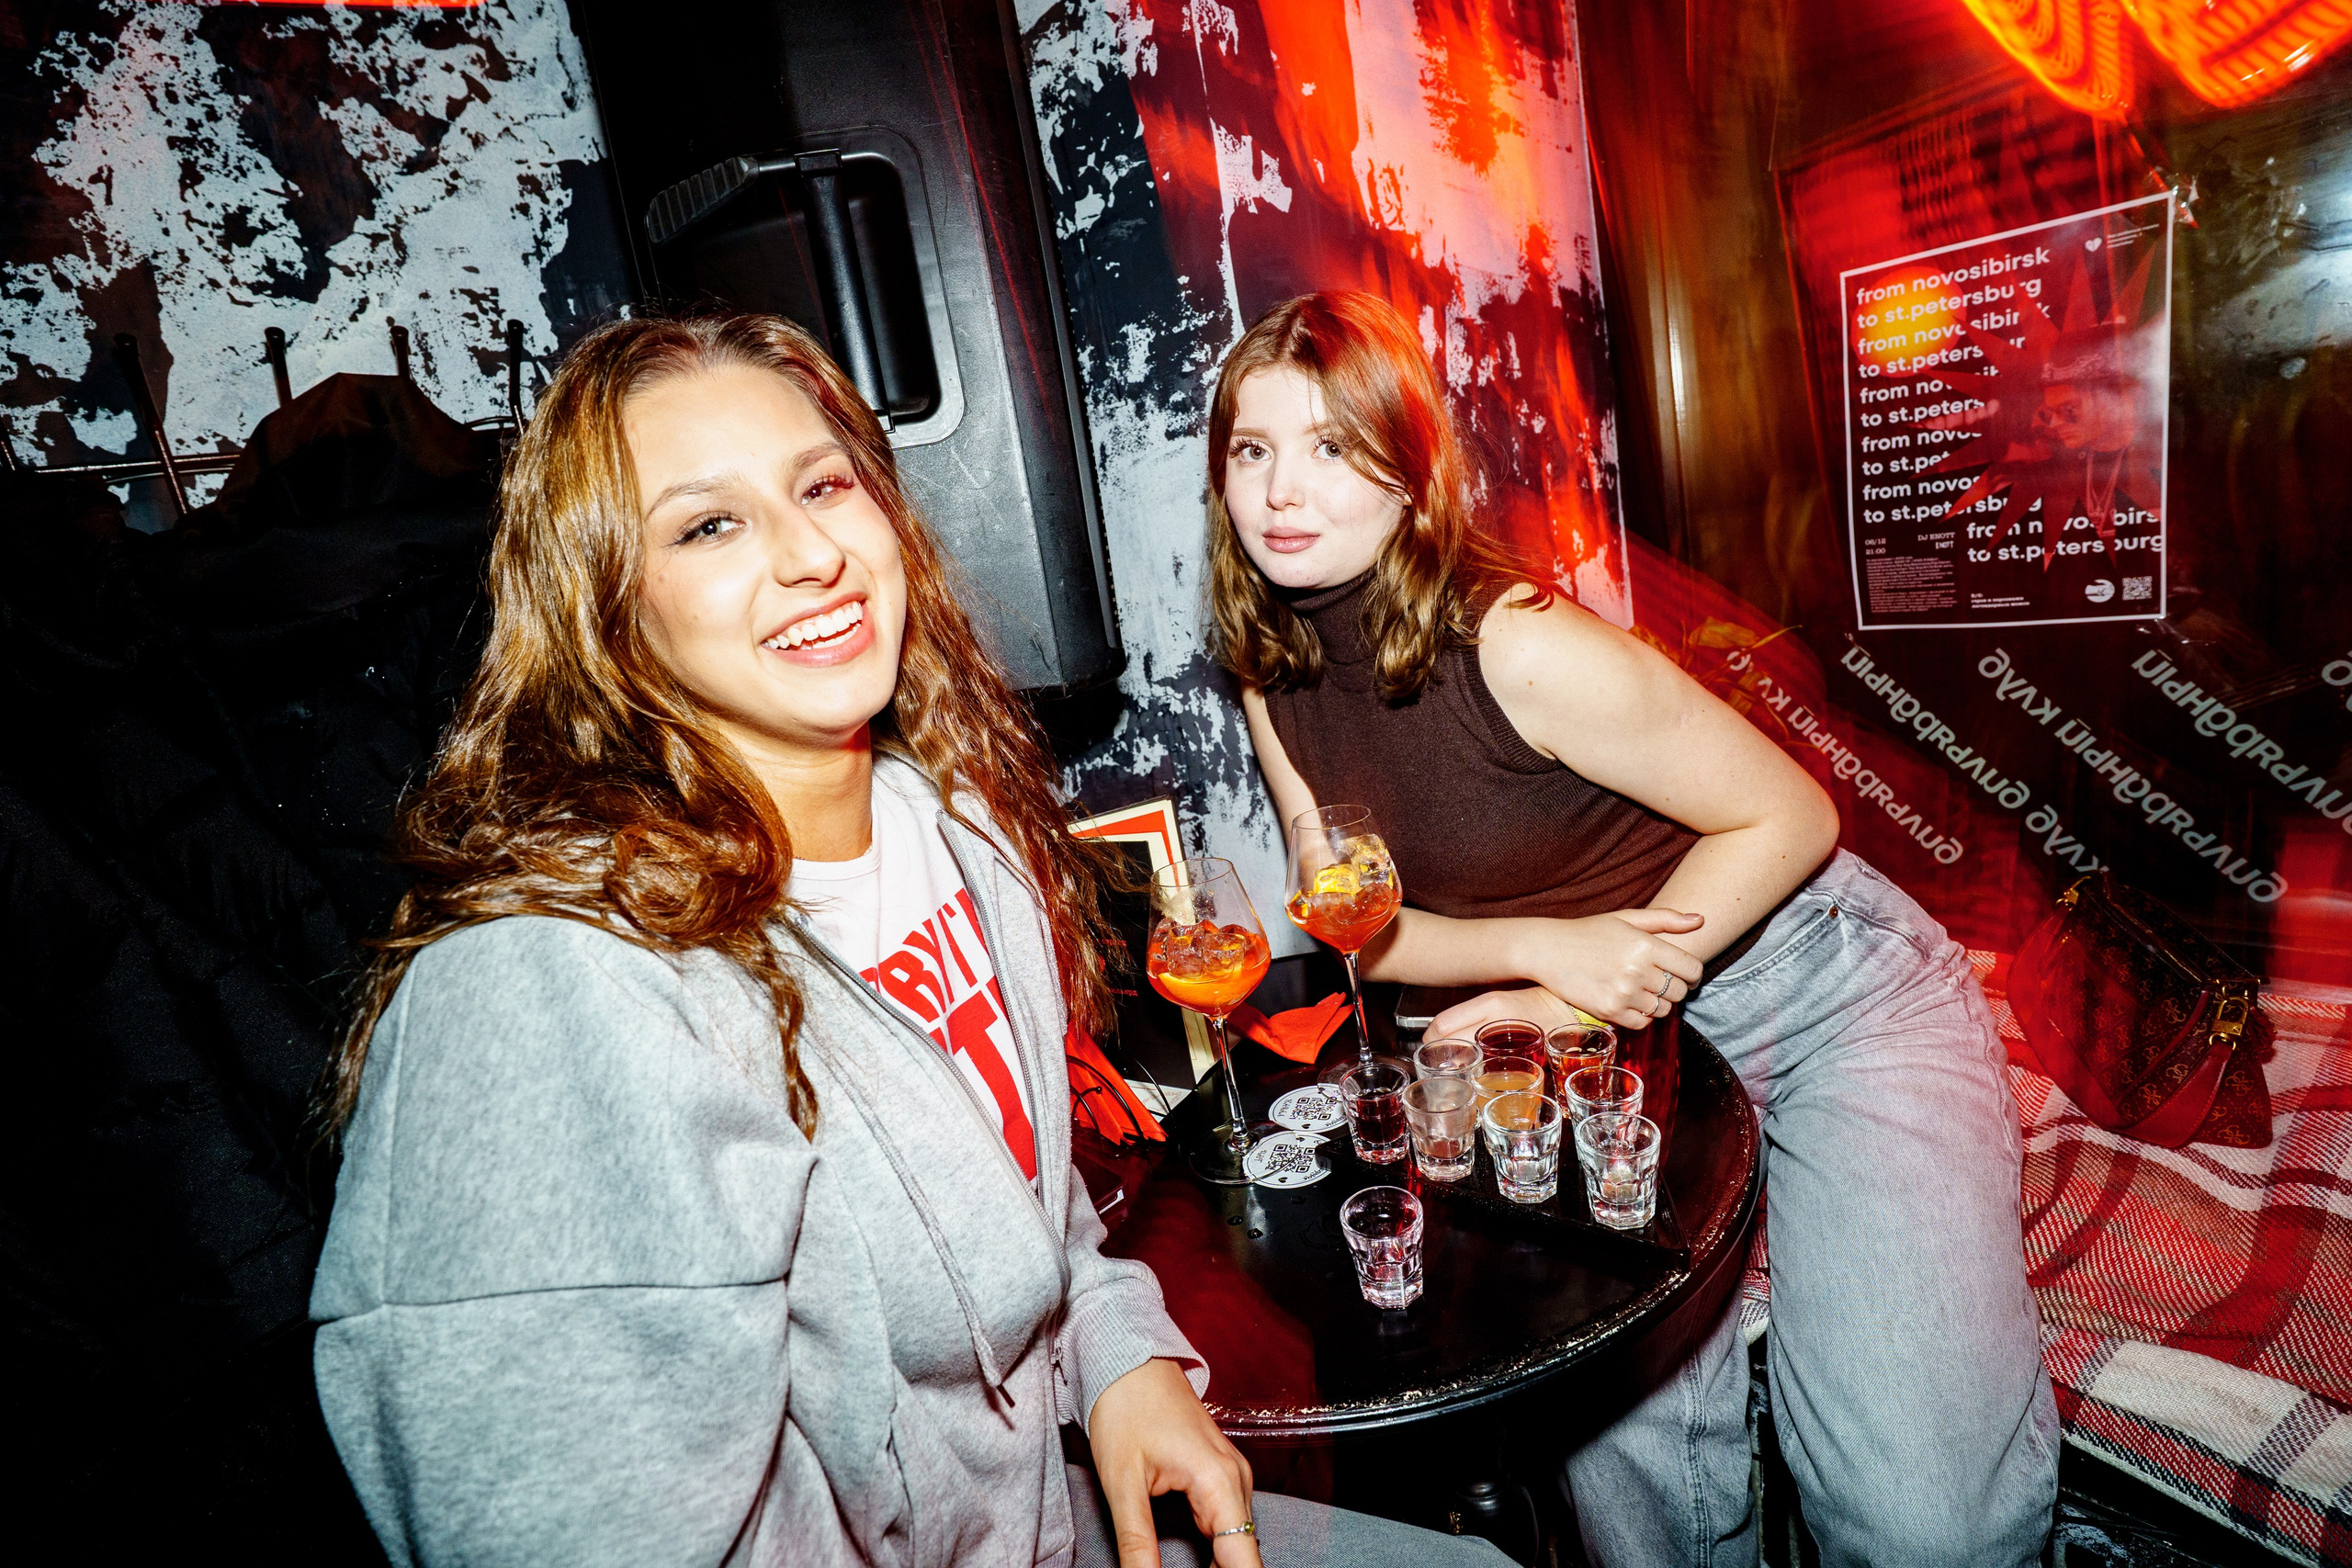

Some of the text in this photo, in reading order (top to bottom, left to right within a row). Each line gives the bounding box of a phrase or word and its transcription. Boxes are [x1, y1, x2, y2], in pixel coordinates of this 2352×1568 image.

[1857, 246, 2051, 305] from novosibirsk
[1857, 313, 1878, 329] to
[1858, 332, 1906, 355] from
[1859, 364, 1880, 378] to
[1860, 385, 1909, 404] from
[1860, 399, 1984, 427] to st.peters
[1861, 434, 1910, 453] from
[1862, 461, 1883, 476] to
[1862, 484, 1911, 501] from
[1863, 510, 1884, 524] to
[1967, 548, 1991, 562] to
